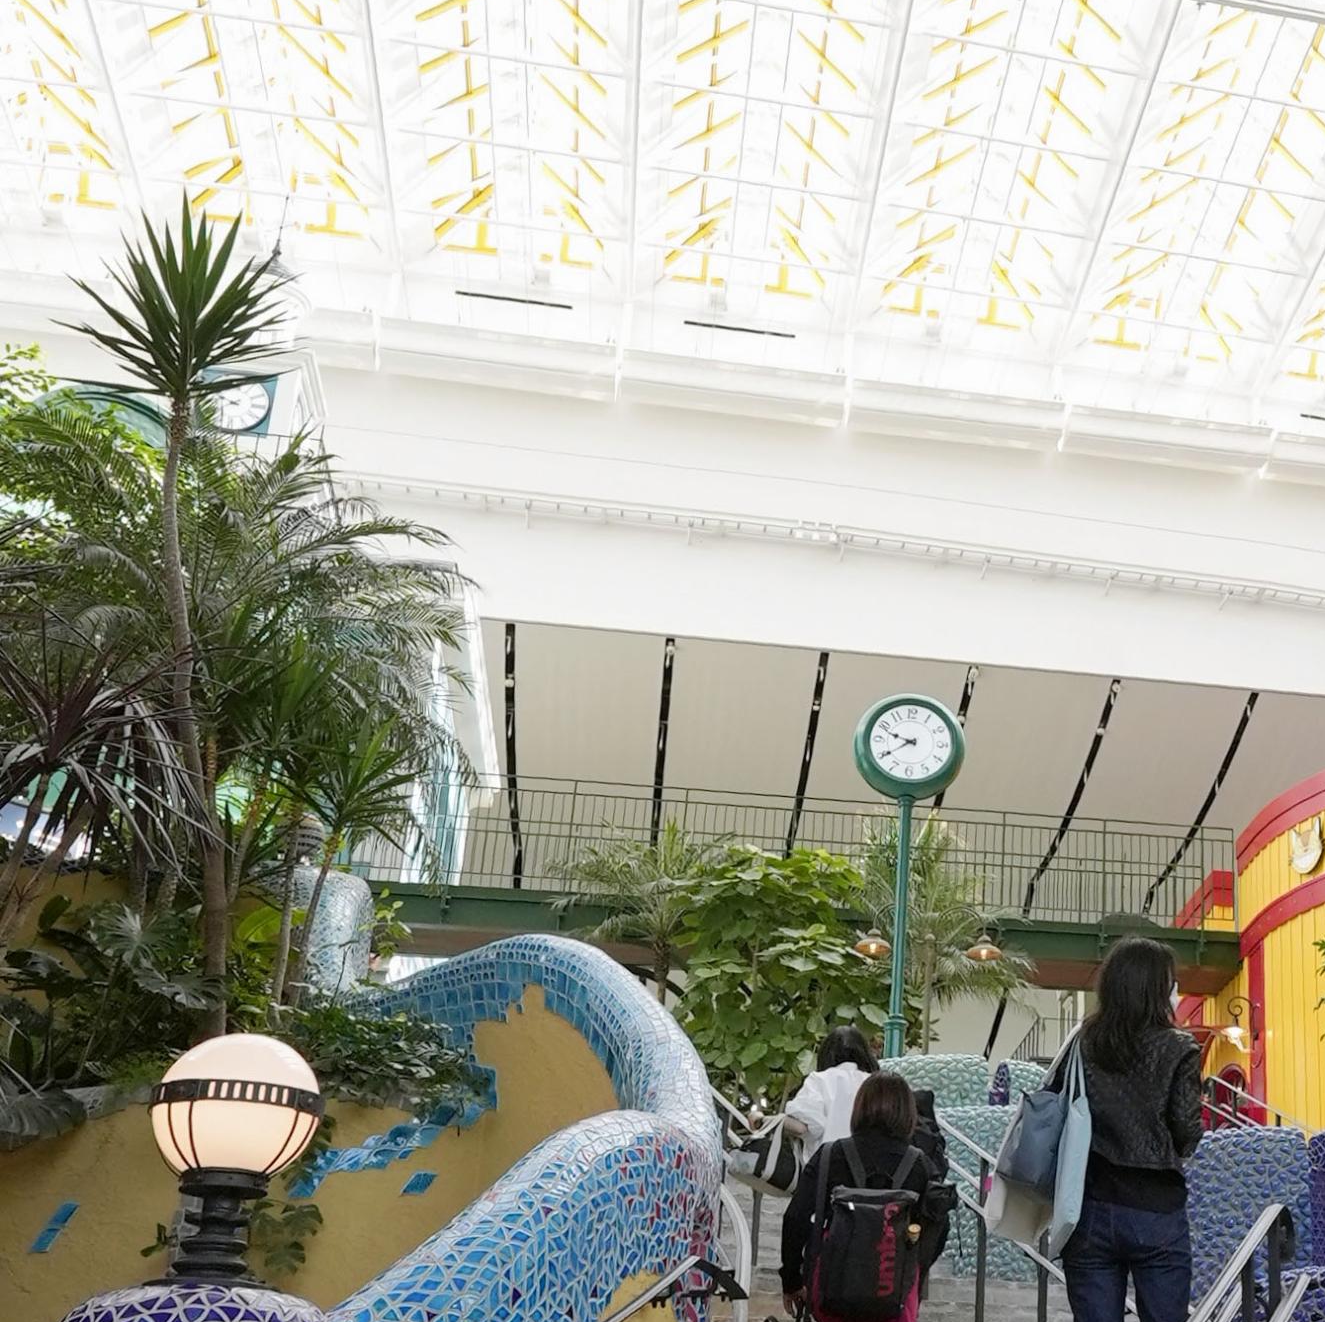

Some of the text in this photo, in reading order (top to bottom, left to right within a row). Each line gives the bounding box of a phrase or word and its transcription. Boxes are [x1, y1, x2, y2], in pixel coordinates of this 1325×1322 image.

[890, 710, 902, 723] 11
[907, 708, 918, 719] 12
[888, 760, 900, 771] 7
[904, 765, 914, 777] 6
[920, 763, 930, 774] 5
[874, 1204, 900, 1297] umbro
